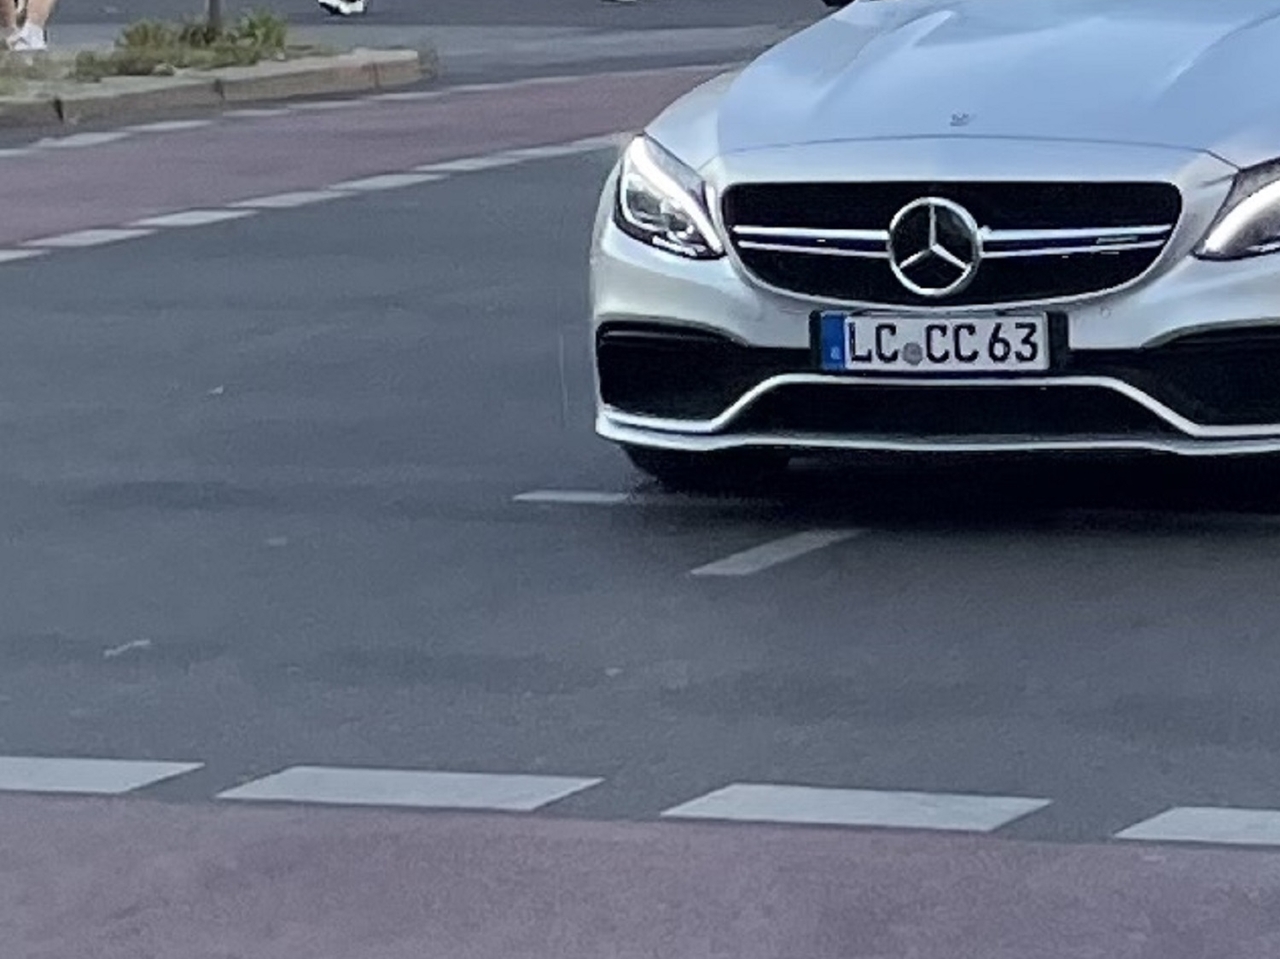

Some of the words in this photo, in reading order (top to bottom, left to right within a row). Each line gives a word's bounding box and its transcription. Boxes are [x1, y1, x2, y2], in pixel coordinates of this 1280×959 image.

[850, 322, 898, 363] LC
[925, 324, 979, 363] CC
[988, 322, 1038, 363] 63
